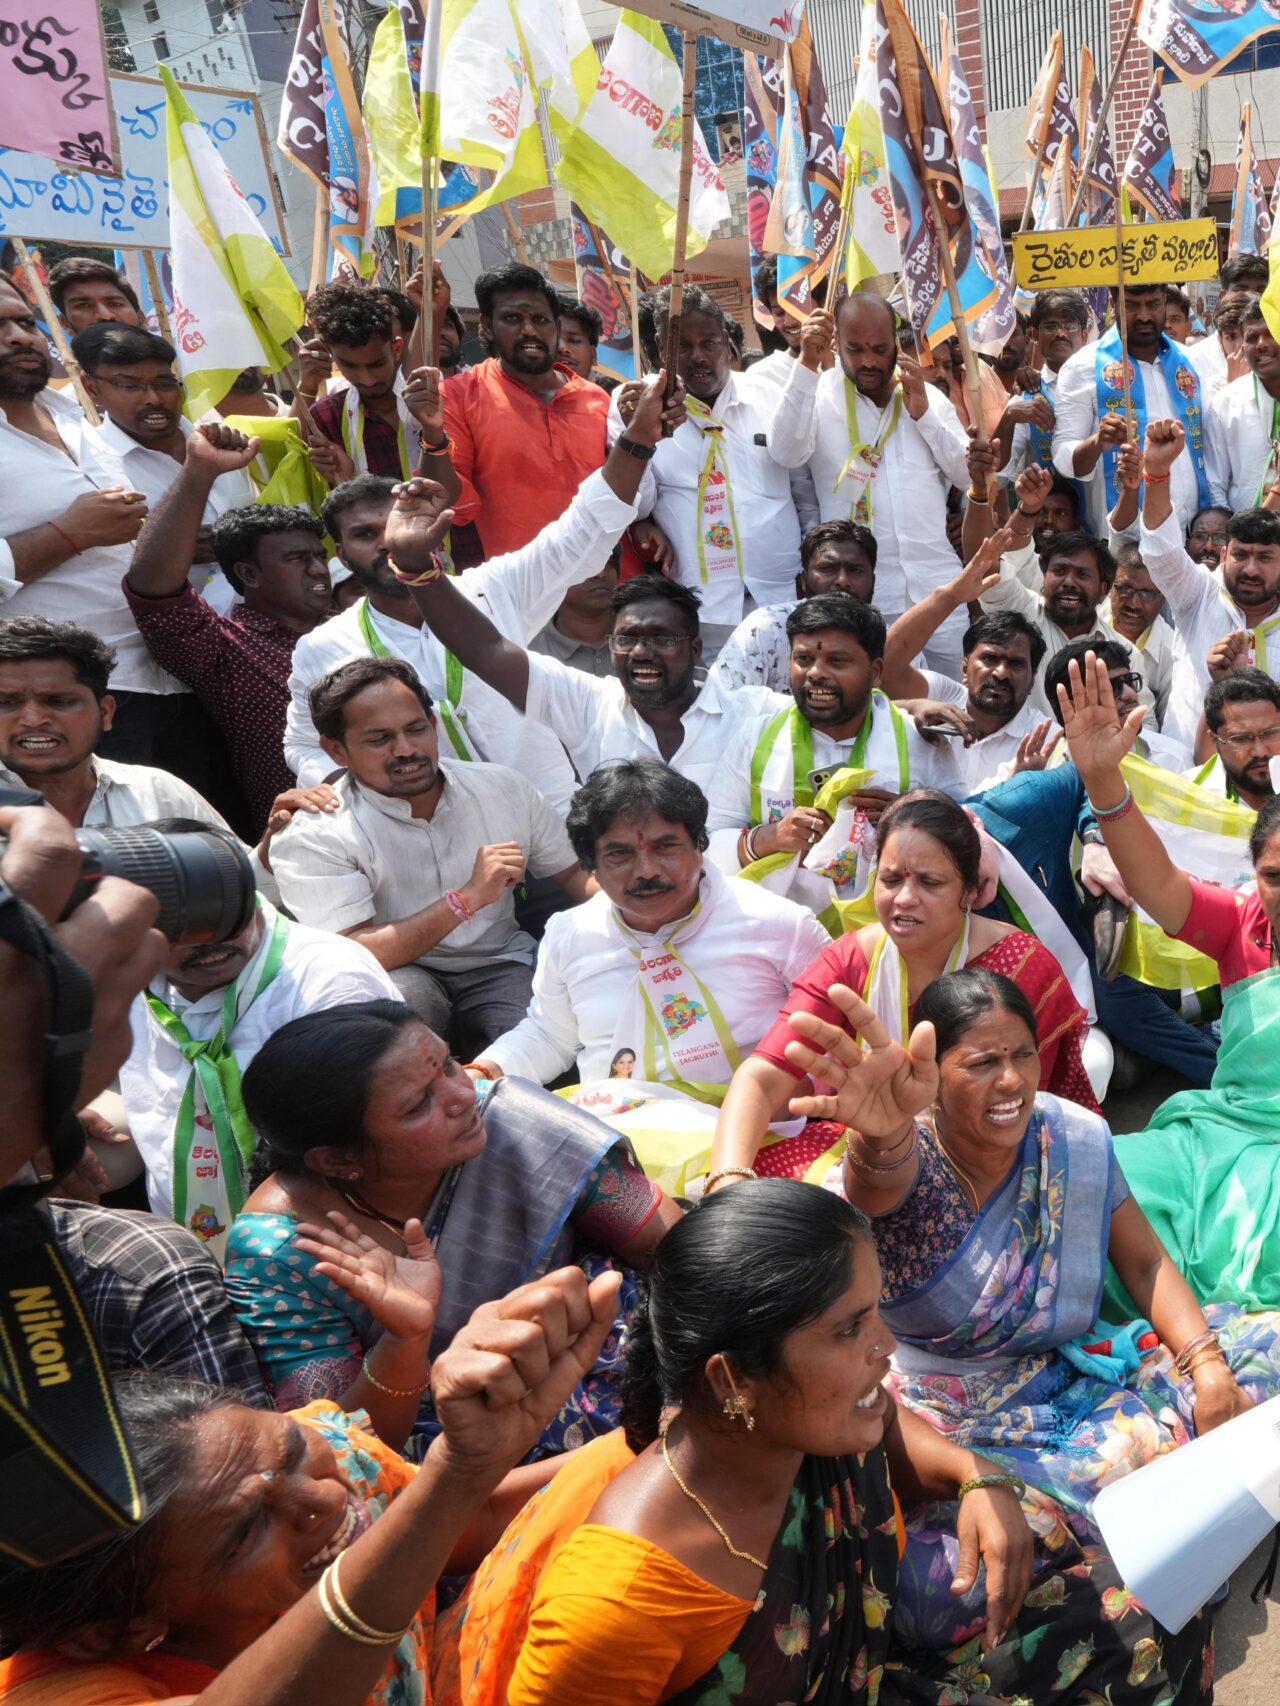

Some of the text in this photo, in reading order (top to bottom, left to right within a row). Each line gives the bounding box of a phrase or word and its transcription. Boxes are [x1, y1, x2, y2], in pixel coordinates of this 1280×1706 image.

[806, 131, 839, 179] JA
[672, 1041, 721, 1059] TELANGANA
[678, 1050, 720, 1066] JAGRUTHI
[10, 1287, 72, 1388] Nikon
